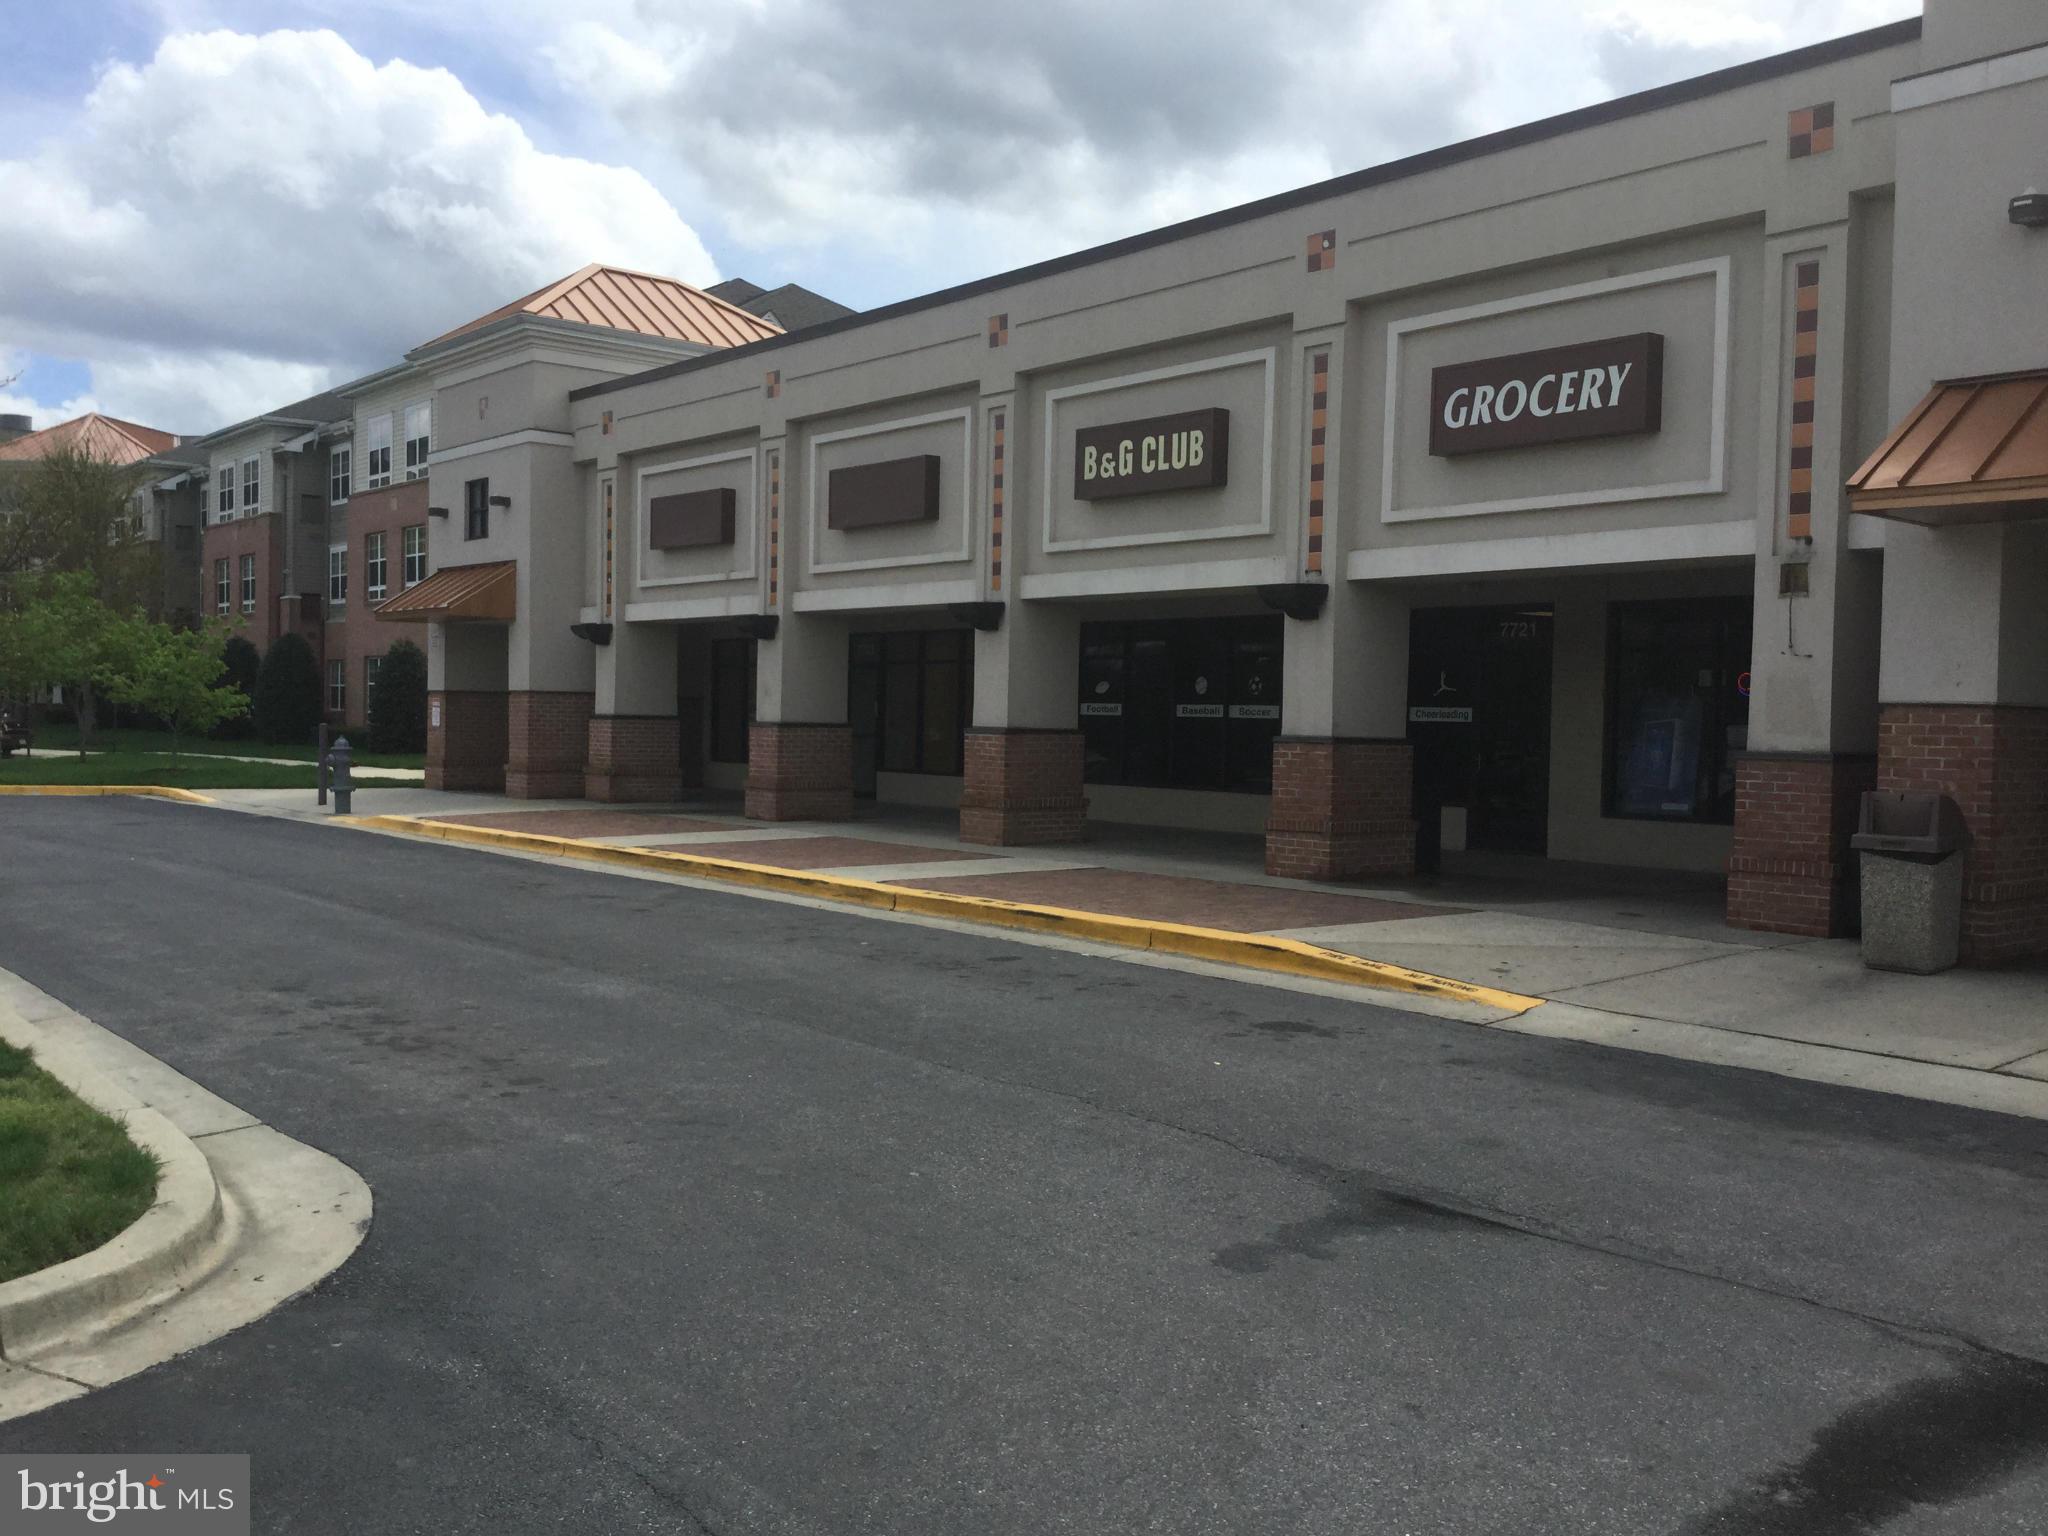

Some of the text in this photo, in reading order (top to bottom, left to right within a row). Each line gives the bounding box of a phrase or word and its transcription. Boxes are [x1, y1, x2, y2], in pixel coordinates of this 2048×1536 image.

[1443, 362, 1633, 429] GROCERY
[1084, 430, 1204, 480] B&G CLUB
[1501, 622, 1536, 638] 7721
[1086, 704, 1119, 713] Football
[1182, 706, 1220, 716] Baseball
[1239, 707, 1271, 717] Soccer
[1415, 709, 1469, 721] Cheerleading
